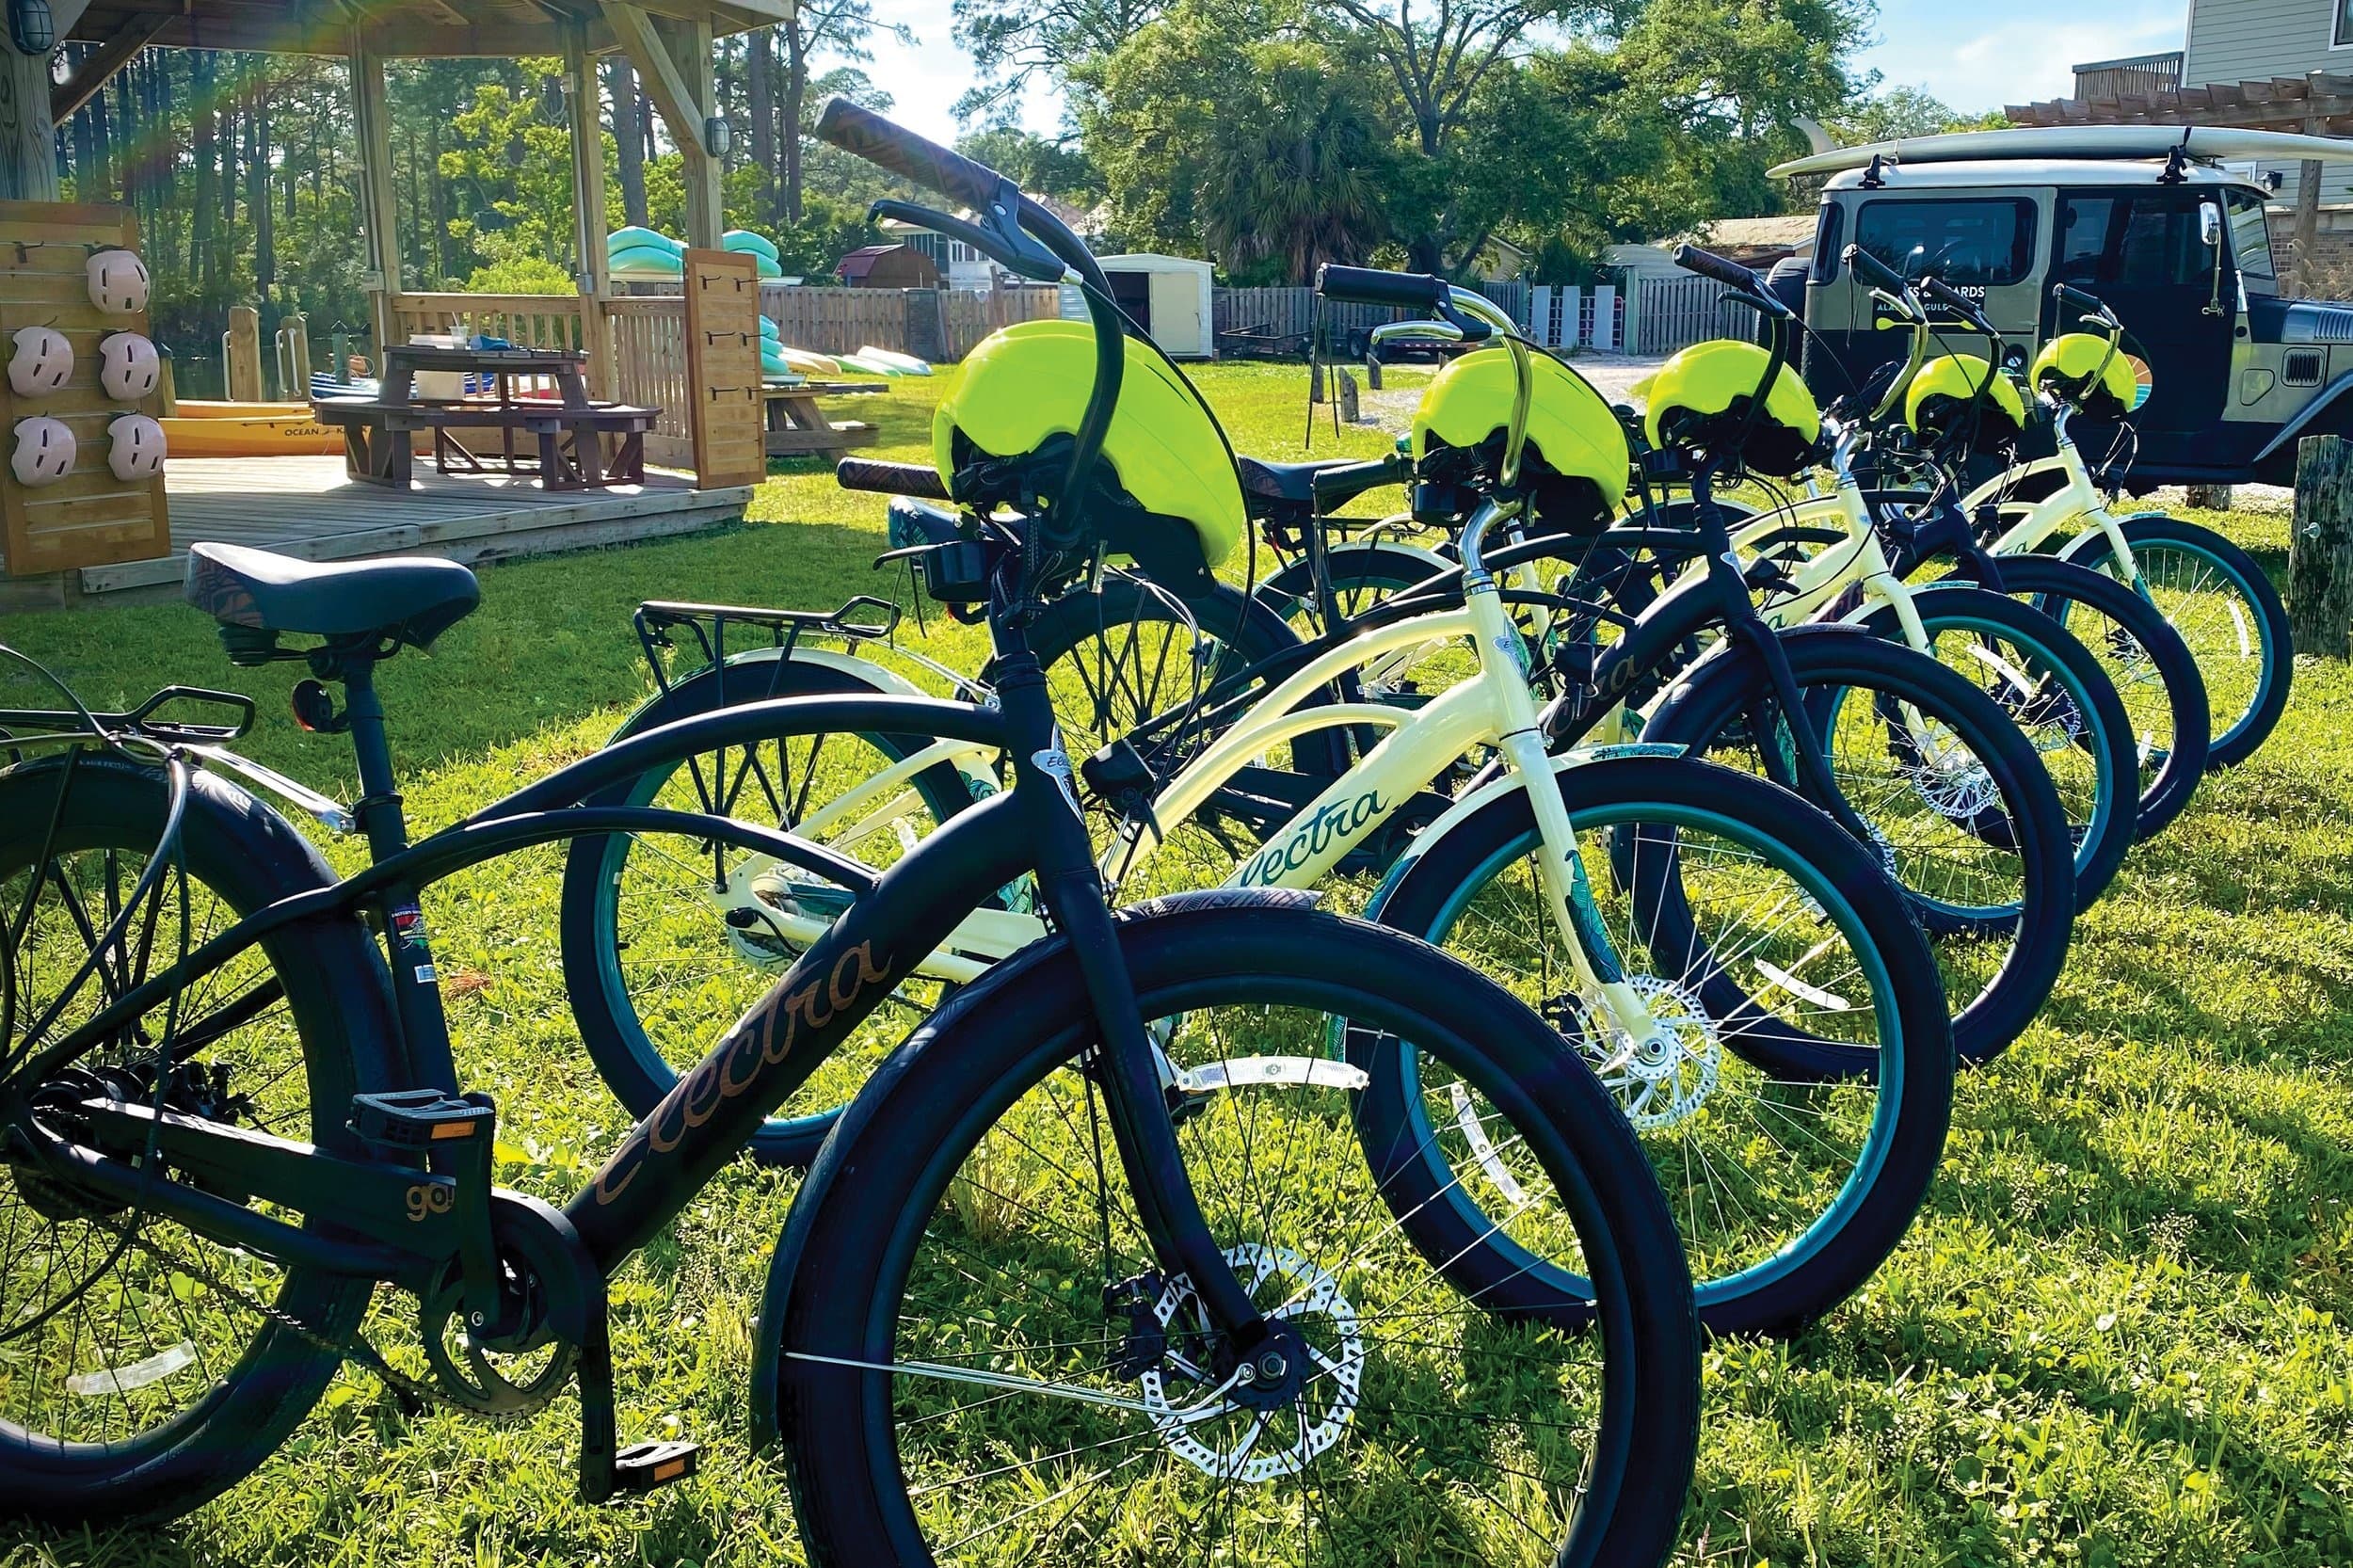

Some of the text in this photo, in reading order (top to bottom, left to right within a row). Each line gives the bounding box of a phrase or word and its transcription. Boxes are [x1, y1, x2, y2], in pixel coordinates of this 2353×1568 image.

[1950, 286, 1985, 297] ARDS
[284, 428, 319, 437] OCEAN
[1241, 789, 1391, 887] lectra
